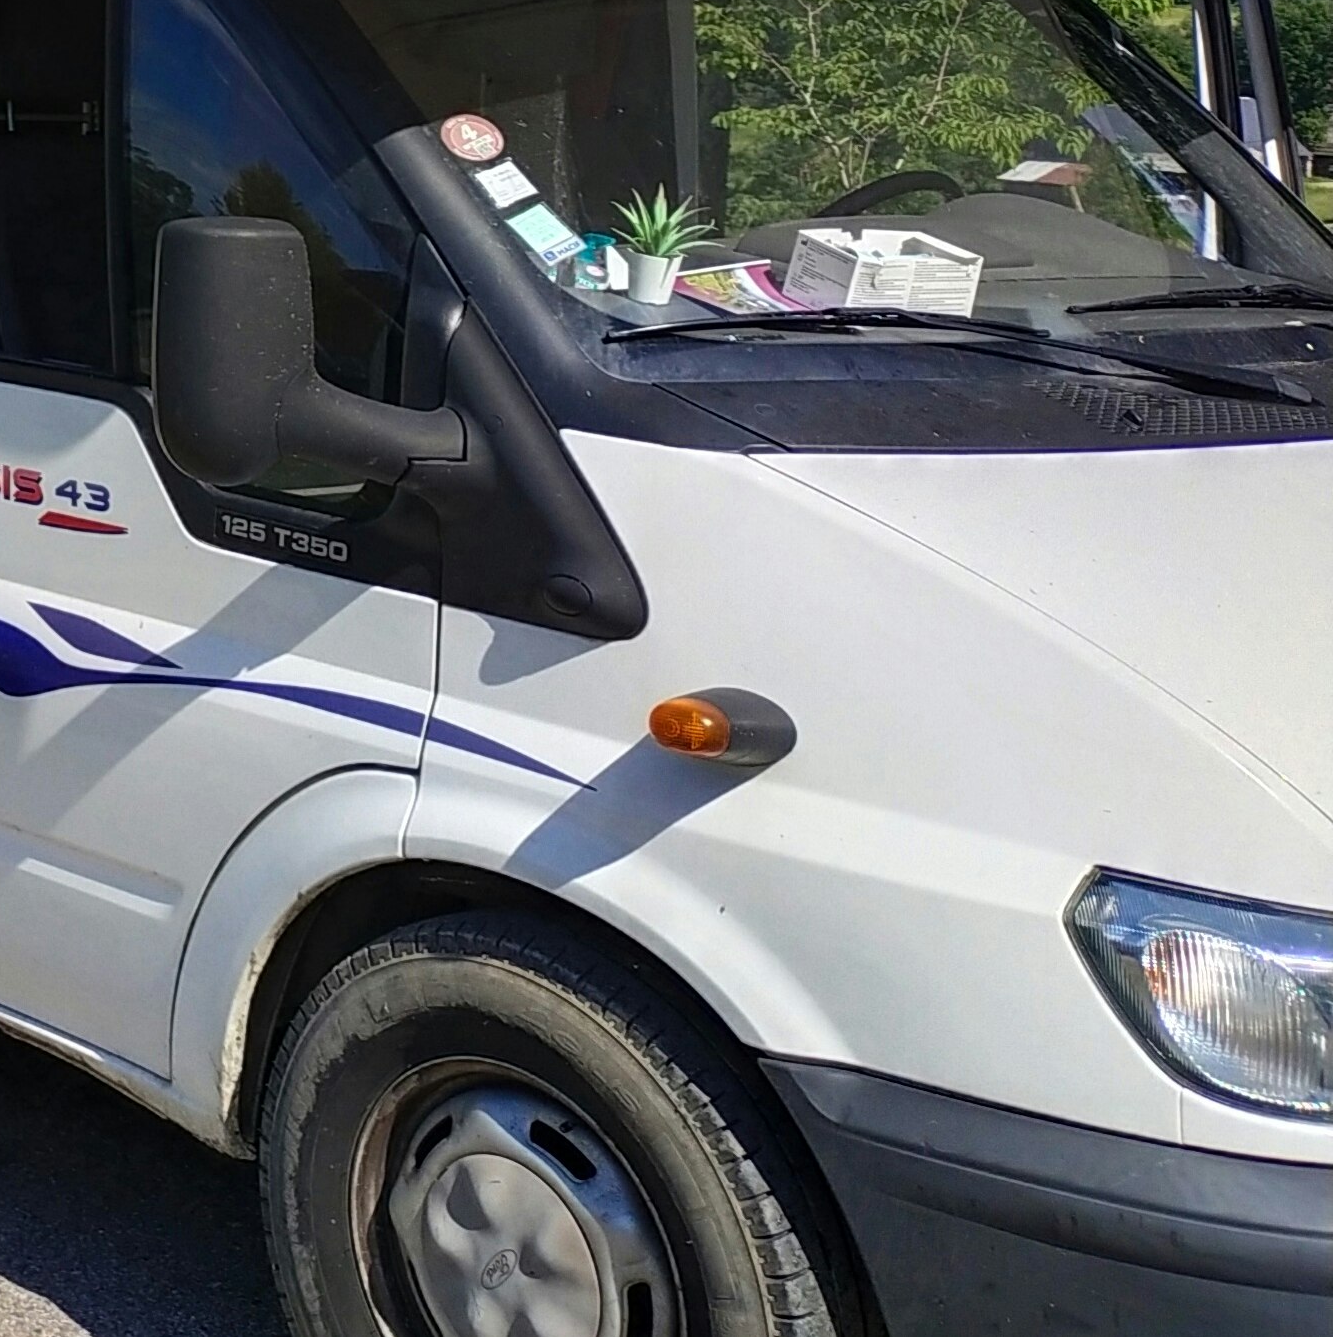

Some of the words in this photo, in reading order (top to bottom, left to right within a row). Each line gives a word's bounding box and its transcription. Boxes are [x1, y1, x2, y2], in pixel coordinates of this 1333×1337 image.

[460, 123, 478, 140] 4
[54, 479, 111, 512] 43
[221, 514, 267, 543] 125
[273, 527, 348, 562] T350
